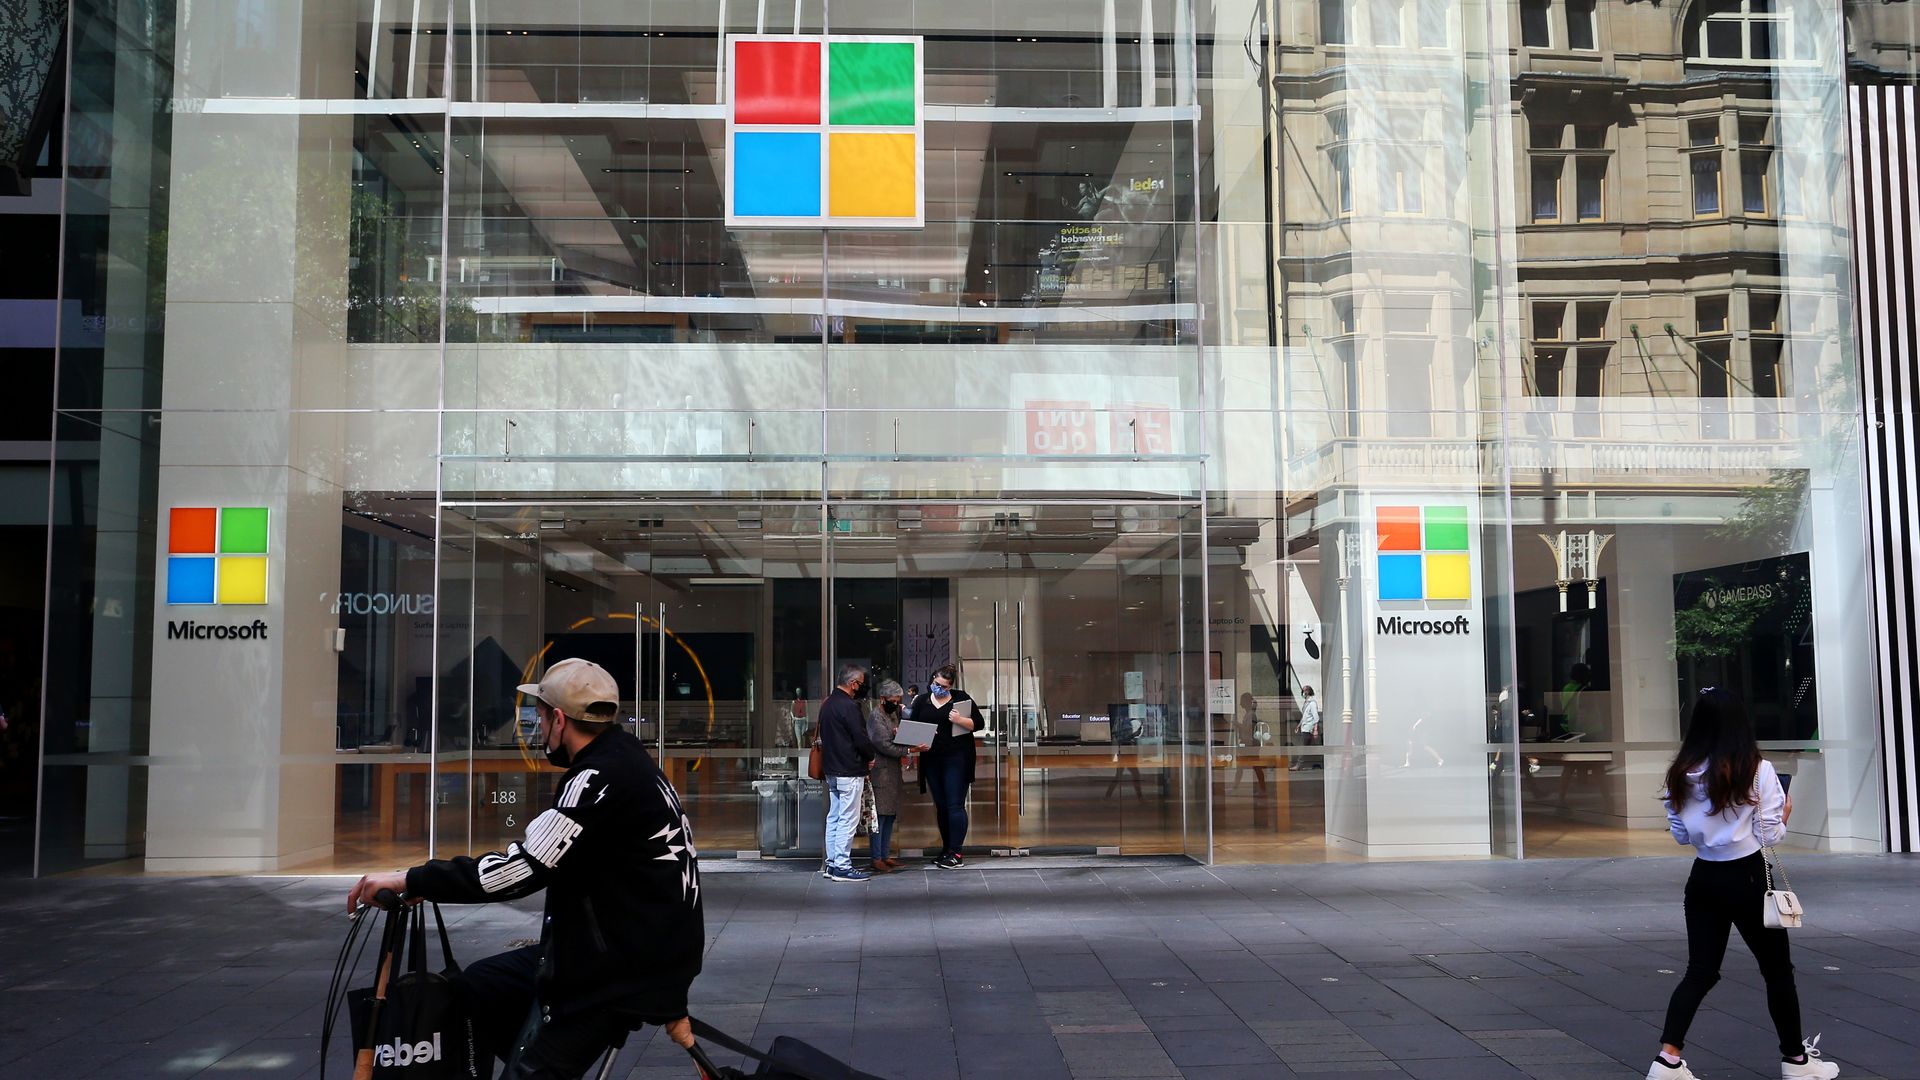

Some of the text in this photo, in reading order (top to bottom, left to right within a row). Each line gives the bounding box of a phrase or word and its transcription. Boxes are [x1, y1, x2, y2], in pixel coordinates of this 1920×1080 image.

[1719, 584, 1772, 604] GAME PASS
[167, 619, 268, 640] Microsoft
[1376, 615, 1470, 635] Microsoft
[491, 790, 517, 804] 188
[373, 1031, 442, 1068] rebel
